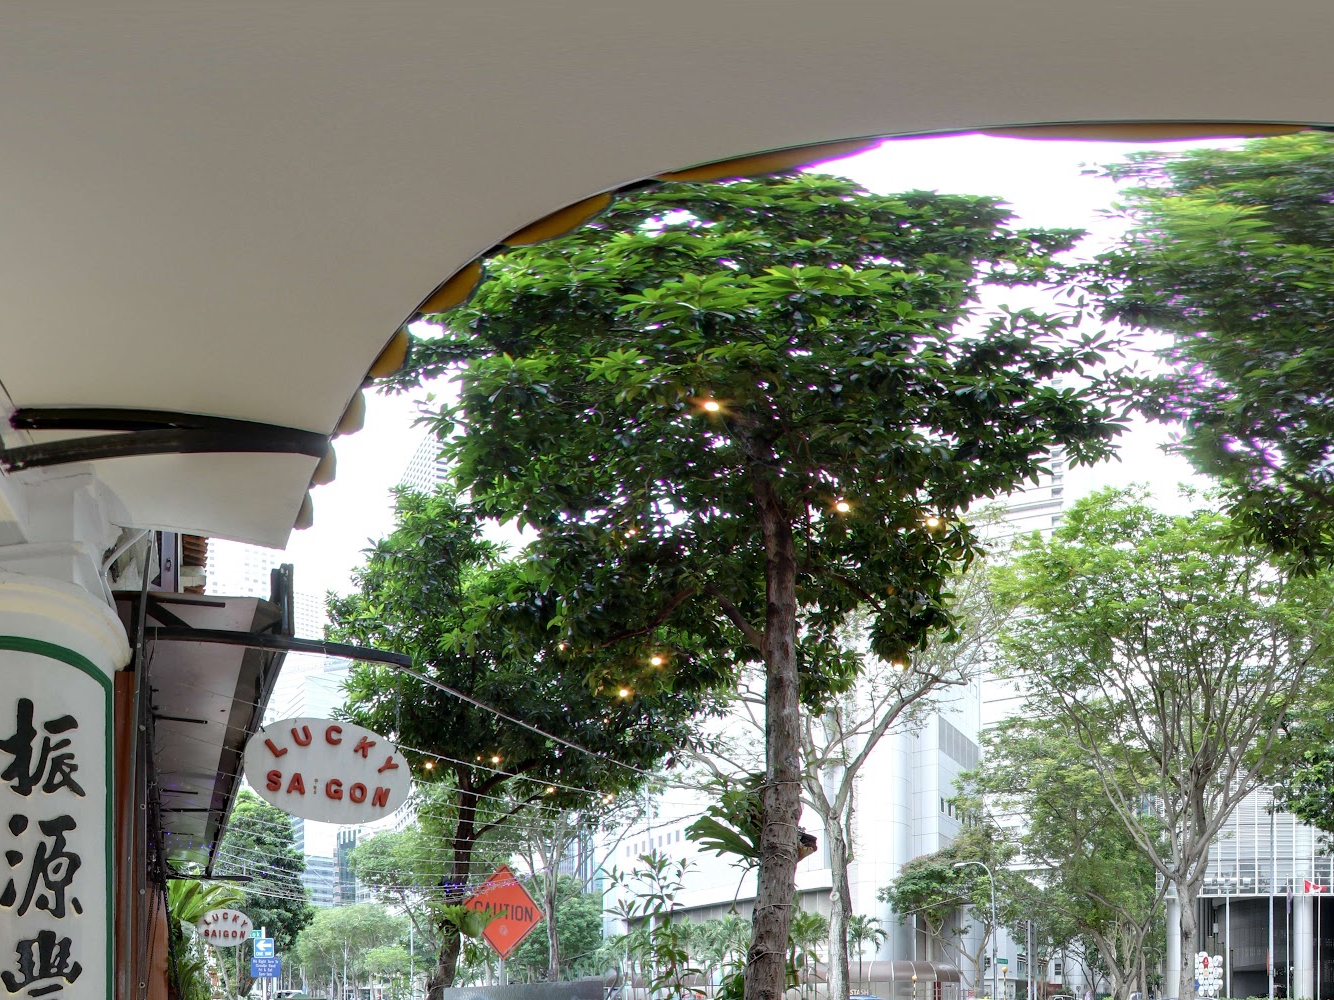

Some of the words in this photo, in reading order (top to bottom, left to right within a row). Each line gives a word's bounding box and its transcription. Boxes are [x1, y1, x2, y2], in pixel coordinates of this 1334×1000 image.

[264, 725, 399, 774] LUCKY
[266, 769, 391, 808] SAGON
[204, 912, 248, 927] LUCKY
[204, 929, 246, 939] SAIGON
